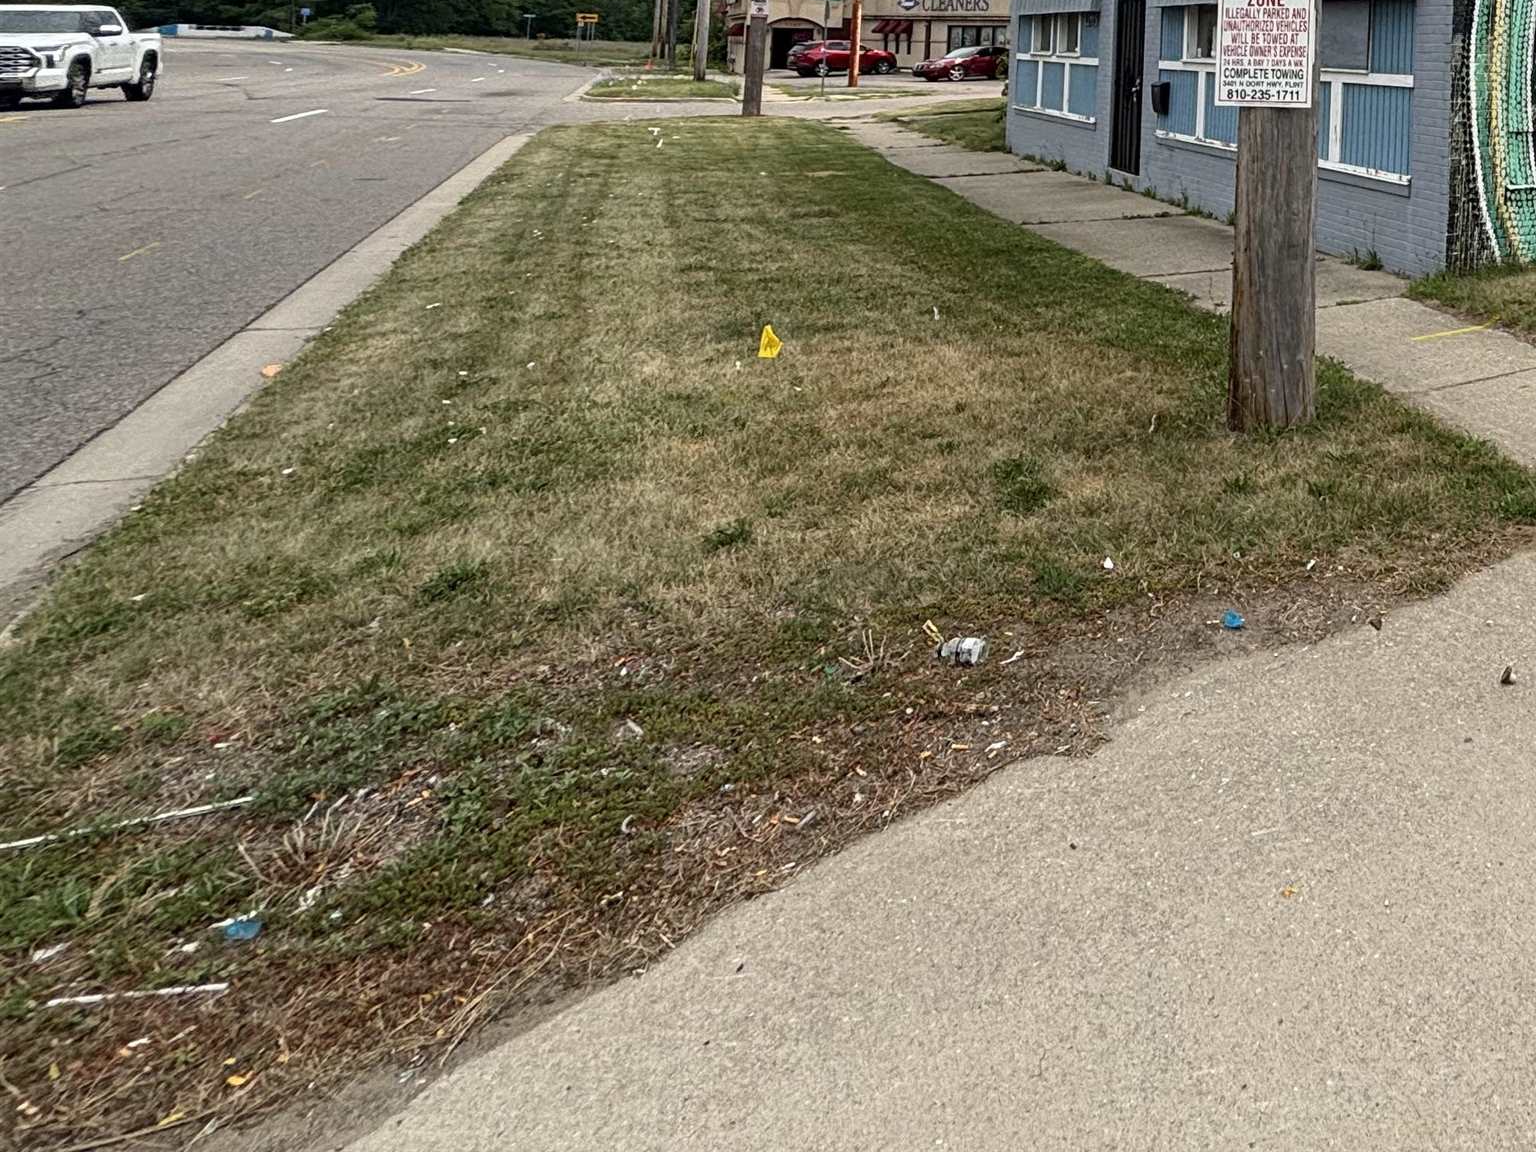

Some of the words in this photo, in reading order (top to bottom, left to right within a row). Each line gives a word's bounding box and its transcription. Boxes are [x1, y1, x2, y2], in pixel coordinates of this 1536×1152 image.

[1225, 8, 1261, 19] ILLEGALLY
[1263, 8, 1290, 19] PARKED
[1292, 8, 1307, 19] AND
[1223, 20, 1274, 32] UNAUTHORIZED
[1276, 20, 1308, 32] VEHICLES
[1231, 33, 1249, 44] WILL
[1251, 33, 1260, 44] BE
[1262, 33, 1288, 44] TOWED
[1290, 33, 1299, 45] AT
[1223, 45, 1247, 57] VEHICLE
[1279, 46, 1306, 58] EXPENSE
[1271, 59, 1287, 67] DAYS
[1288, 59, 1292, 67] A
[1223, 67, 1269, 79] COMPLETE
[1270, 68, 1304, 80] TOWING
[1226, 88, 1300, 101] 810-235-1711
